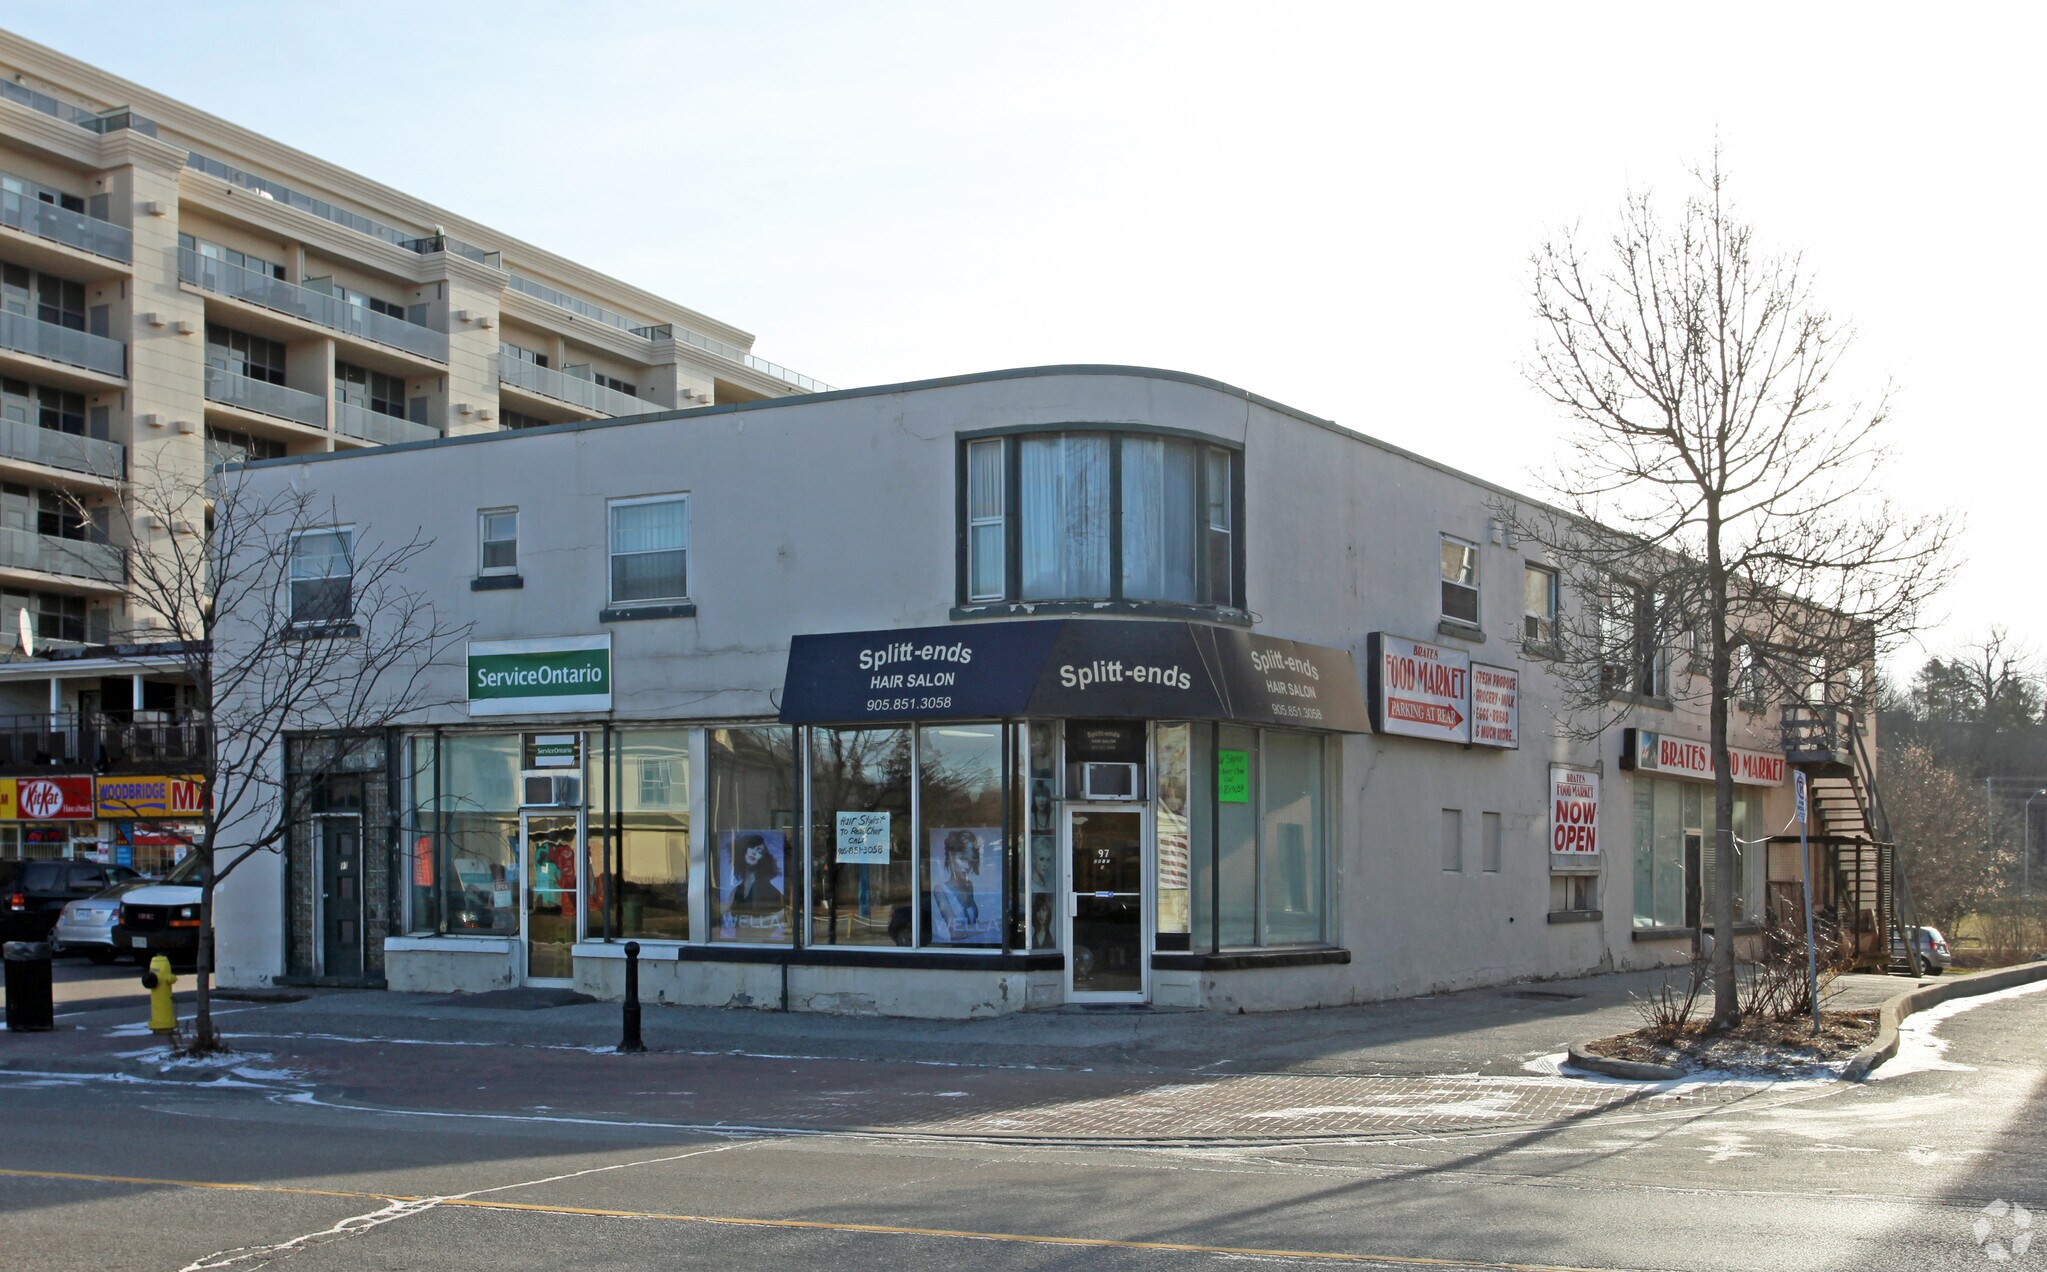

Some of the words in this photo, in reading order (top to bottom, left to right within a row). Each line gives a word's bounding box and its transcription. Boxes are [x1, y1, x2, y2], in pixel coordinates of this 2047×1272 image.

[860, 642, 972, 671] Splitt-ends
[1413, 645, 1438, 660] BRATES
[1251, 650, 1319, 680] Splitt-ends
[478, 663, 602, 687] ServiceOntario
[870, 675, 903, 689] HAIR
[906, 672, 954, 687] SALON
[1060, 660, 1191, 690] Splitt-ends
[1386, 654, 1415, 691] FOOD
[1418, 660, 1466, 700] MARKET
[1476, 670, 1492, 686] FRESH
[1493, 674, 1516, 690] PRODUCE
[1266, 680, 1288, 694] HAIR
[1288, 683, 1316, 698] SALON
[866, 696, 952, 711] 905.851.3058
[1476, 689, 1498, 705] GROCERY
[1501, 694, 1515, 708] MILK
[1272, 704, 1322, 720] 905.851.3058
[1392, 702, 1424, 720] PARKING
[1426, 708, 1436, 721] AT
[1437, 708, 1456, 724] REAR
[1476, 707, 1488, 720] EGGS
[1492, 710, 1509, 724] BREAD
[1481, 726, 1496, 740] MUCH
[1661, 740, 1705, 771] BRATES
[1743, 754, 1784, 782] MARKET
[1567, 773, 1585, 783] BRATES
[26, 784, 59, 815] KitKat
[100, 783, 166, 800] WOODBRIDGE
[1557, 784, 1571, 796] FOOD
[1573, 785, 1594, 798] MARKET
[840, 817, 857, 825] Hair
[1556, 800, 1596, 824] NOW
[1554, 824, 1596, 851] OPEN
[1098, 849, 1110, 858] 97
[722, 912, 782, 928] WELLA
